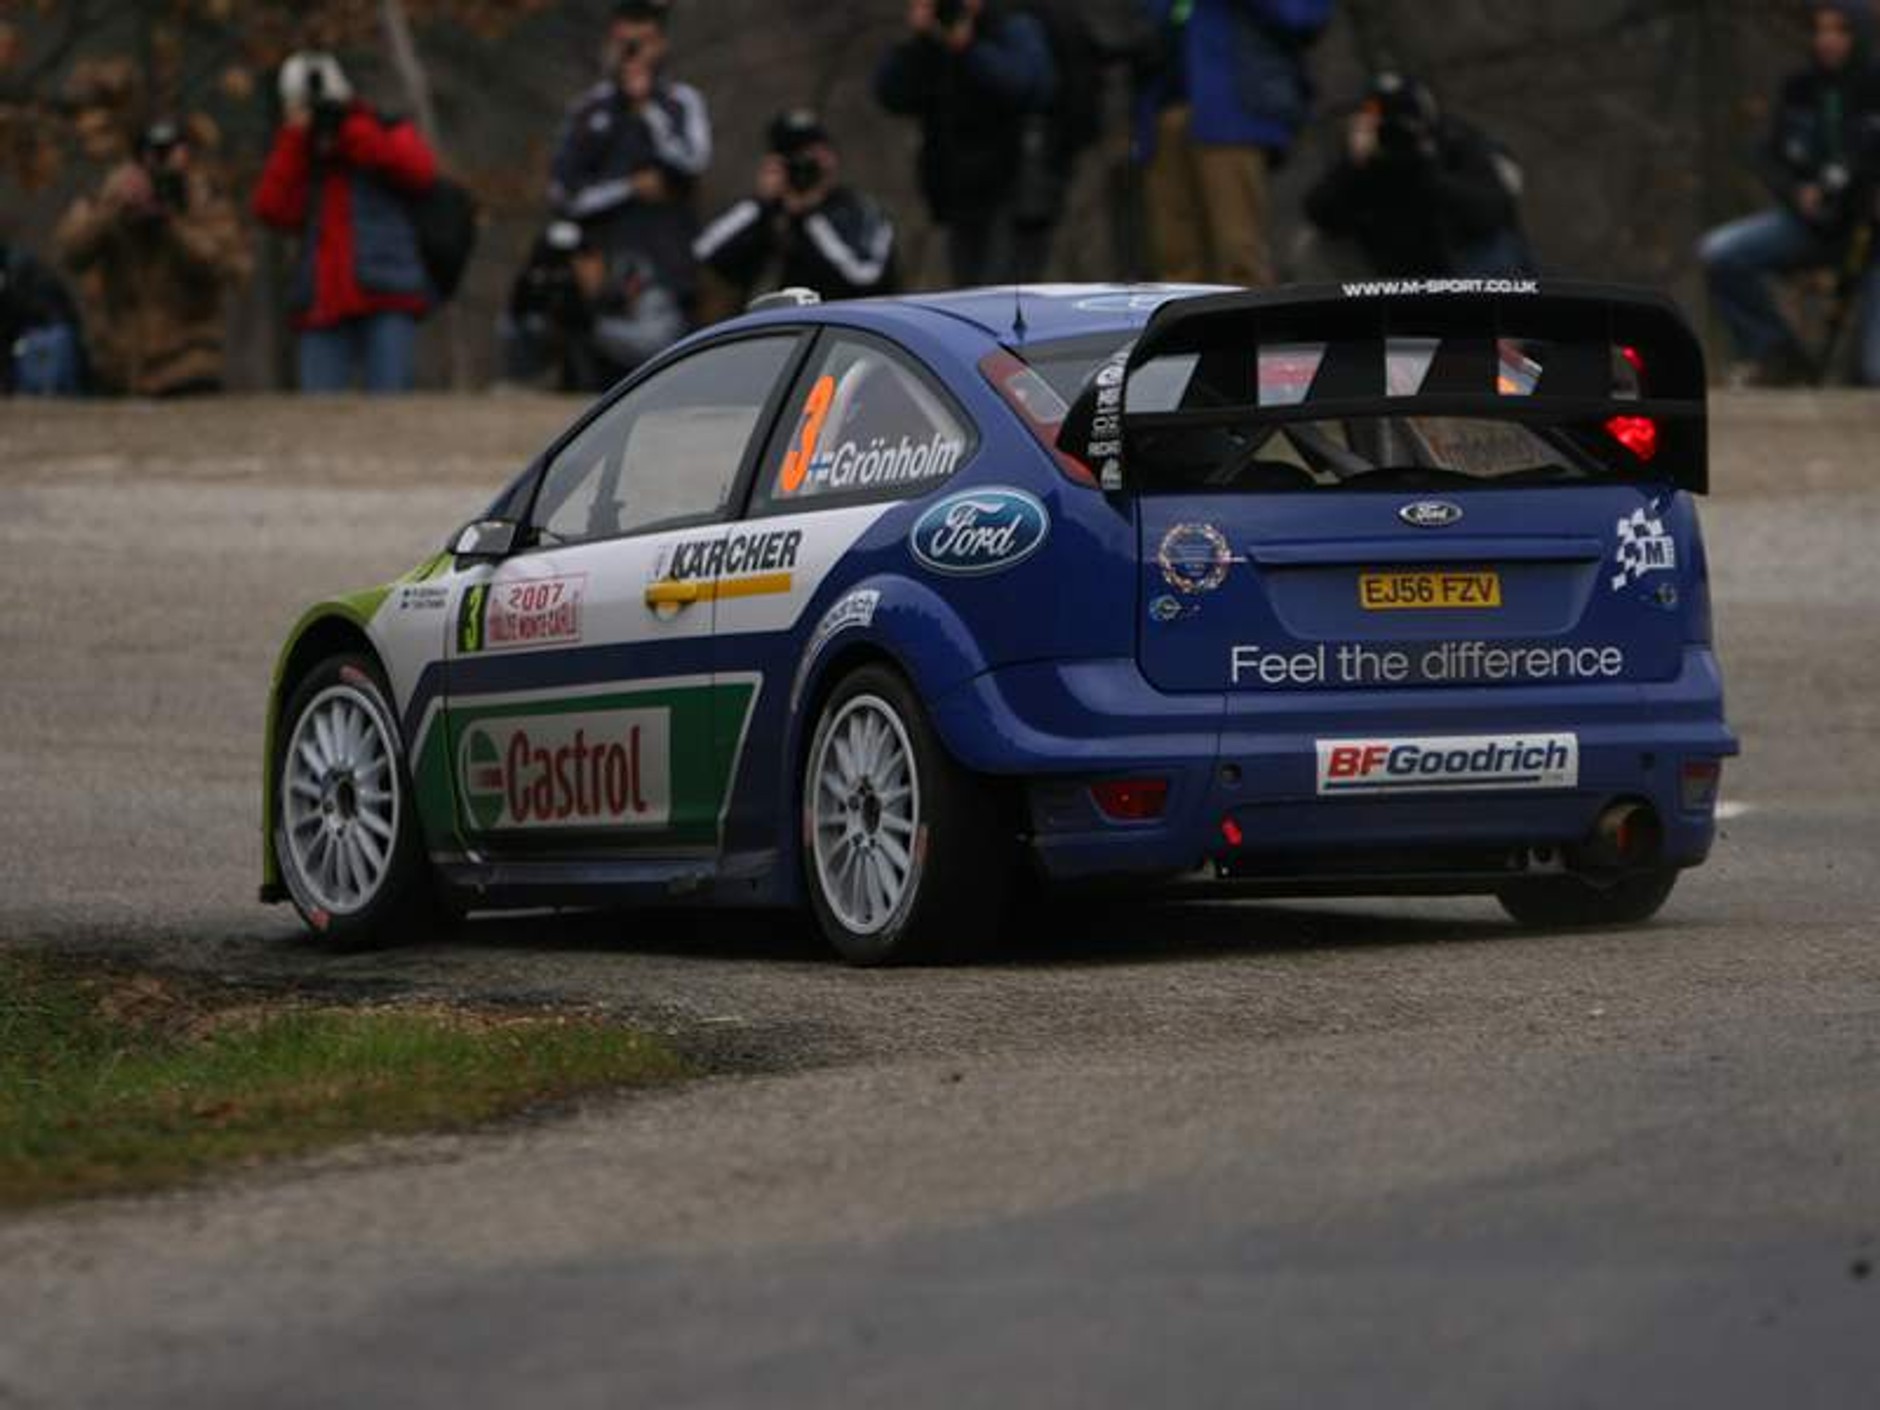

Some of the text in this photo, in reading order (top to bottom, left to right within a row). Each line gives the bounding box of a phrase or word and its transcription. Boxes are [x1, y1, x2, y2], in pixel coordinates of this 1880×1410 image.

[1342, 279, 1539, 297] WWW.M-SPORT.CO.UK
[780, 375, 836, 492] 3
[829, 434, 959, 487] Grönholm
[930, 500, 1022, 556] Ford
[1415, 502, 1448, 521] Ford
[669, 529, 803, 579] KÄRCHER
[508, 582, 566, 612] 2007
[1364, 576, 1494, 604] EJ56 FZV
[464, 584, 485, 651] 3
[1230, 641, 1623, 685] Feel the difference
[506, 724, 649, 823] Castrol
[1327, 739, 1569, 778] BFGoodrich
